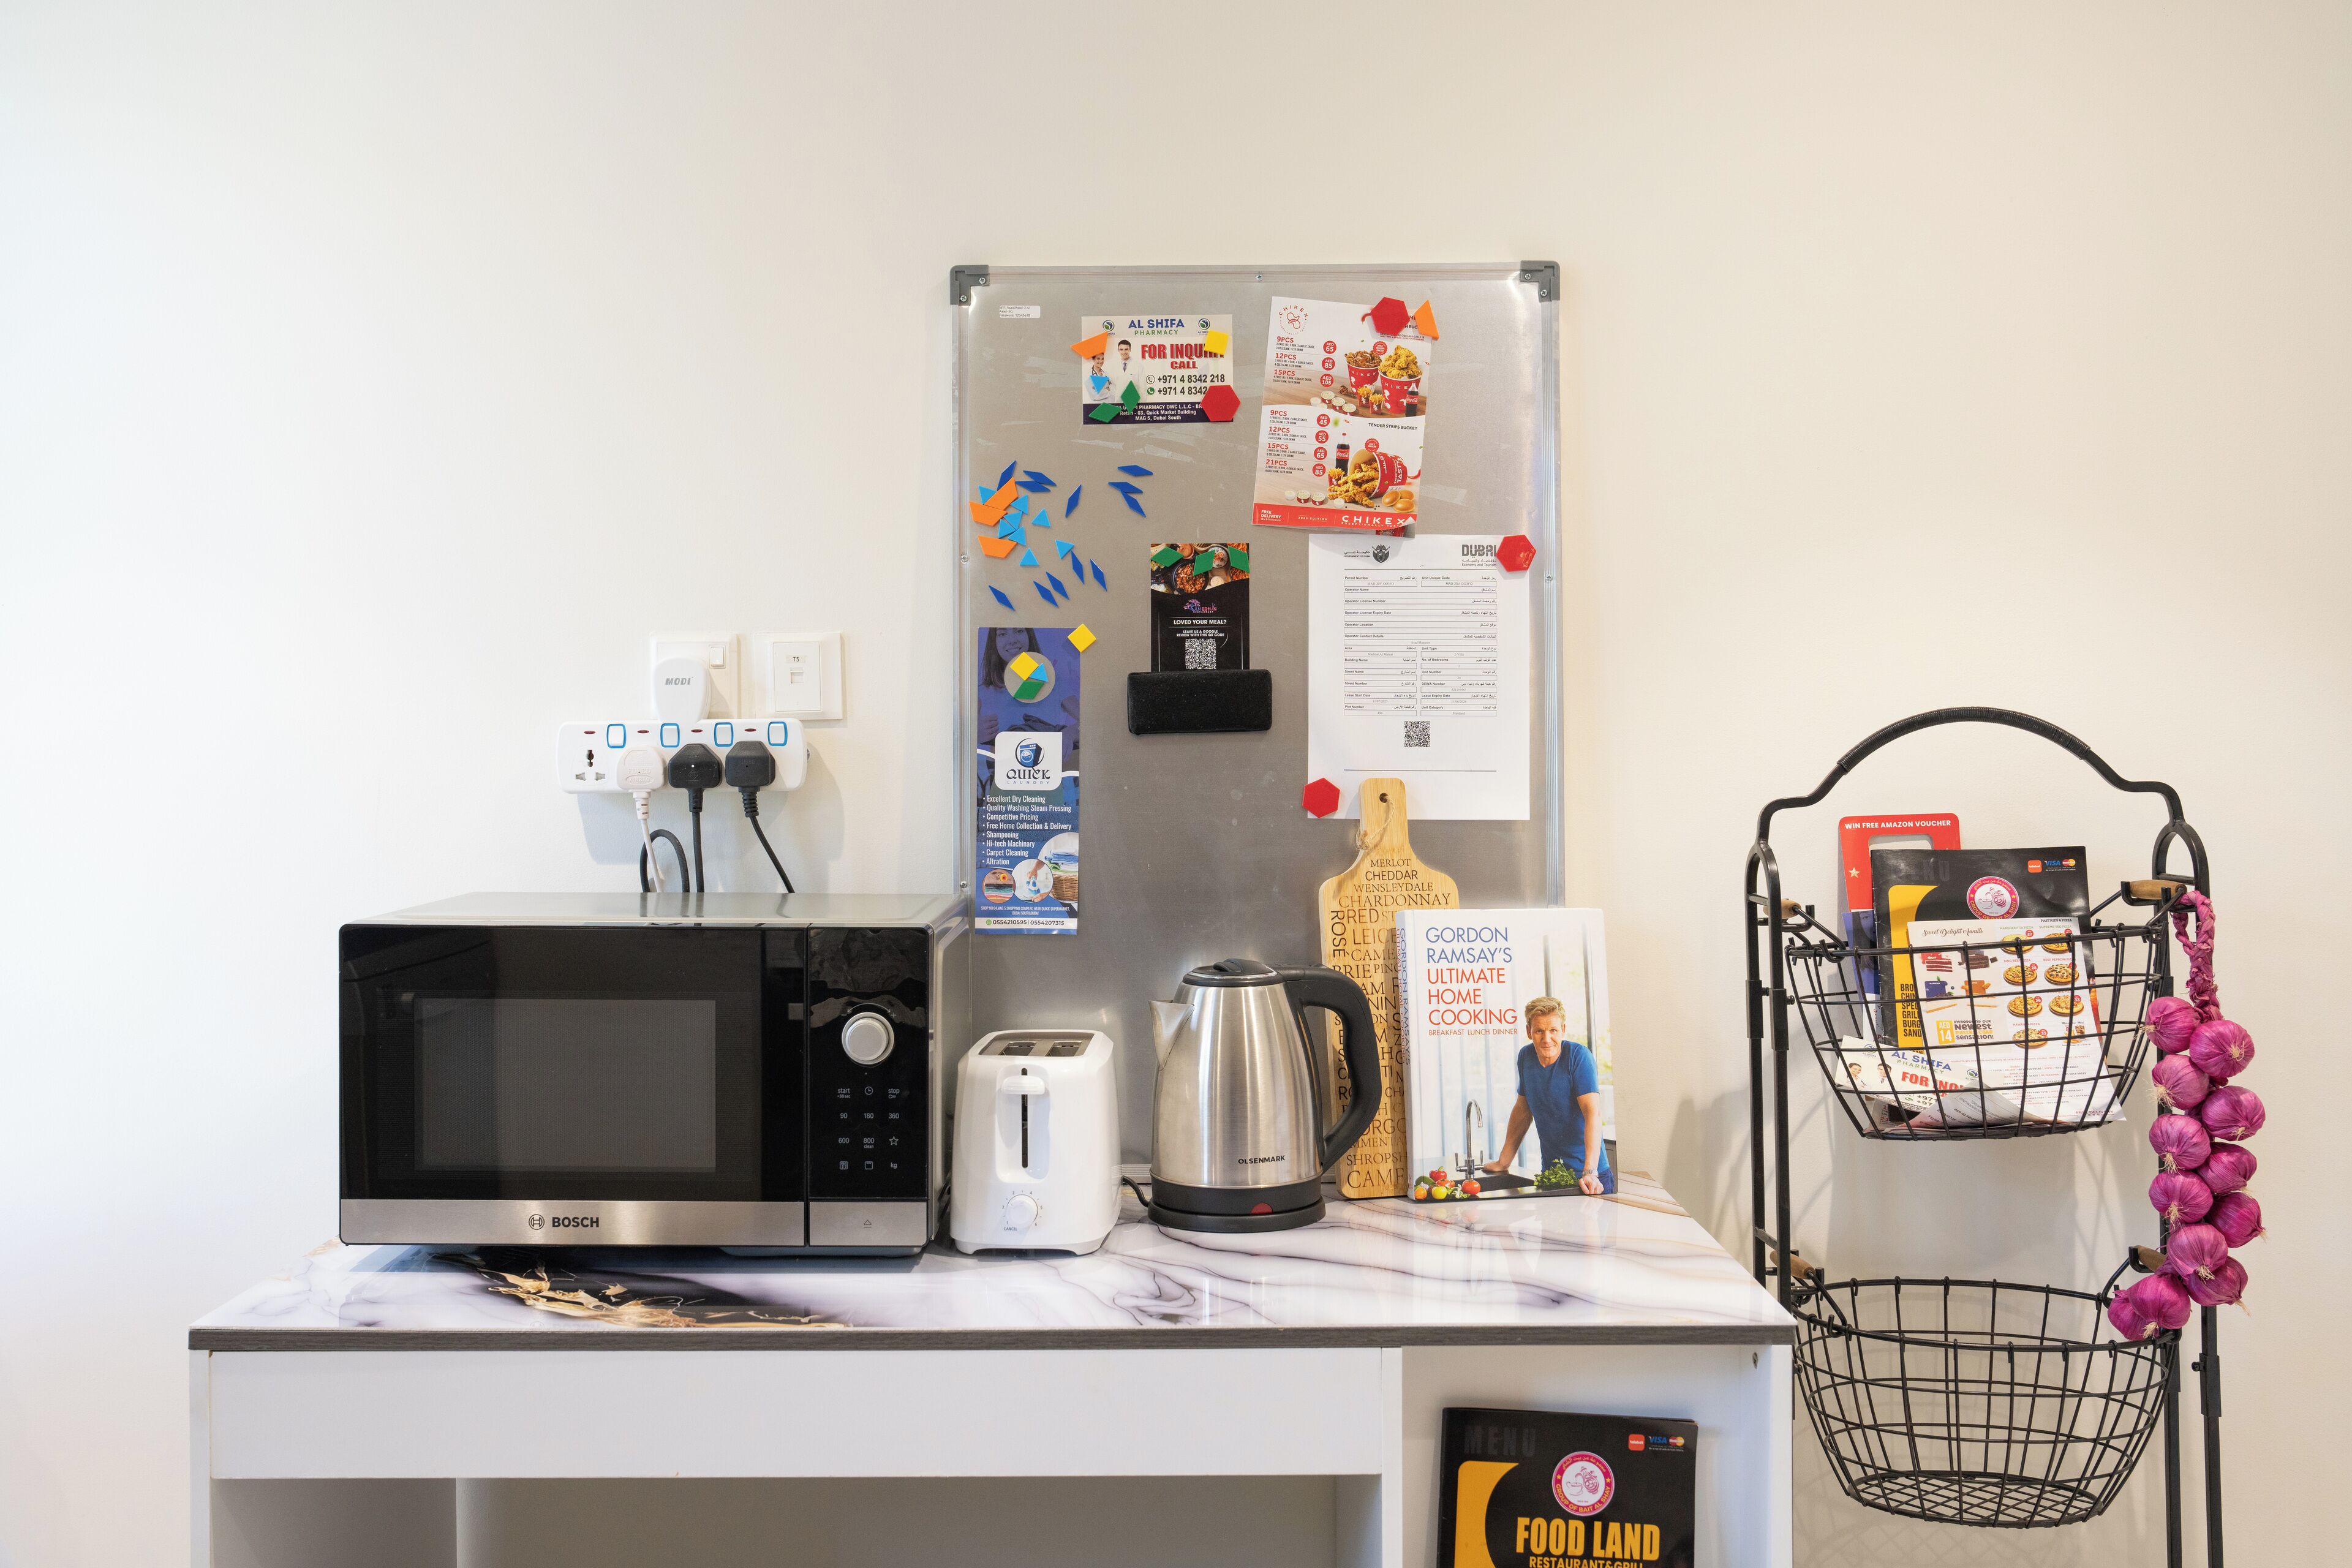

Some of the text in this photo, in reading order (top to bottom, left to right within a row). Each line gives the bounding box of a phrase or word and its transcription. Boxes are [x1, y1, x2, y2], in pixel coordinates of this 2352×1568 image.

[1128, 318, 1185, 329] AL SHIFA
[1141, 343, 1225, 360] FOR INQU
[1170, 361, 1198, 370] CALL
[1157, 374, 1225, 383] +971 4 8342 218
[1158, 386, 1208, 396] +971 4 8342
[1342, 515, 1405, 525] CHIKEX
[1006, 769, 1050, 780] QUICK
[1023, 795, 1046, 804] Cleaning
[1020, 813, 1038, 822] Pricing
[1050, 822, 1072, 831] Delivery
[1370, 858, 1411, 867] MERLOT
[1365, 870, 1418, 881] CHEDDAR
[1354, 882, 1434, 893] WENSLEYDALE
[1339, 893, 1451, 908] CHARDONNAY
[1347, 908, 1379, 924] RED
[1426, 927, 1508, 943] GORDON
[1922, 928, 1983, 937] Sweet Delight Awaits
[1427, 947, 1512, 963] RAMSAY'S
[1427, 968, 1506, 984] ULTIMATE
[1428, 989, 1482, 1005] HOME
[1429, 1008, 1517, 1025] COOKING
[1939, 1030, 1953, 1042] 14
[1891, 1050, 1951, 1071] AL SHIFA
[1901, 1071, 1929, 1088] FOR
[1238, 1155, 1285, 1164] OLSENMARK
[552, 1216, 600, 1228] BOSCH
[1556, 1483, 1569, 1505] GROUP
[1601, 1486, 1611, 1503] SHAY
[1516, 1517, 1660, 1561] FOOD LAND
